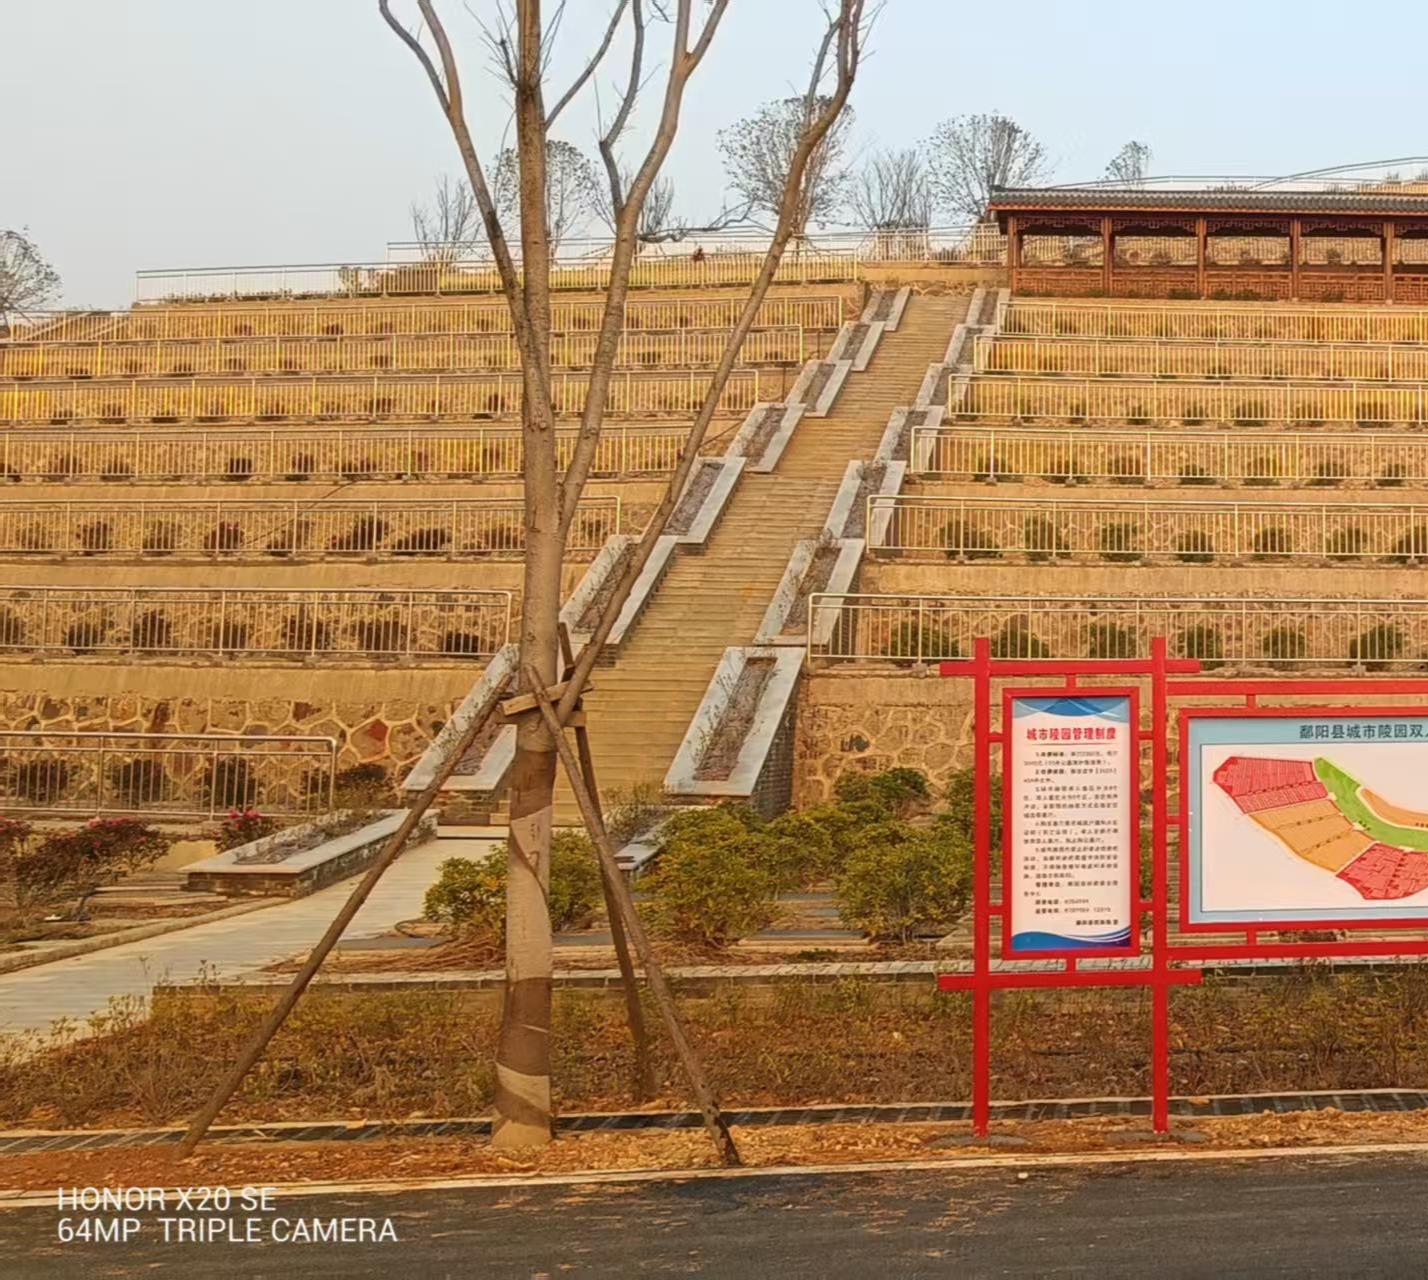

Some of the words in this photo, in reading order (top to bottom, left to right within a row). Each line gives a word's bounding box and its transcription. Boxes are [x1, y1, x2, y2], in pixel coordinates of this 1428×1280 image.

[1026, 727, 1117, 741] 城市陵园管理制度
